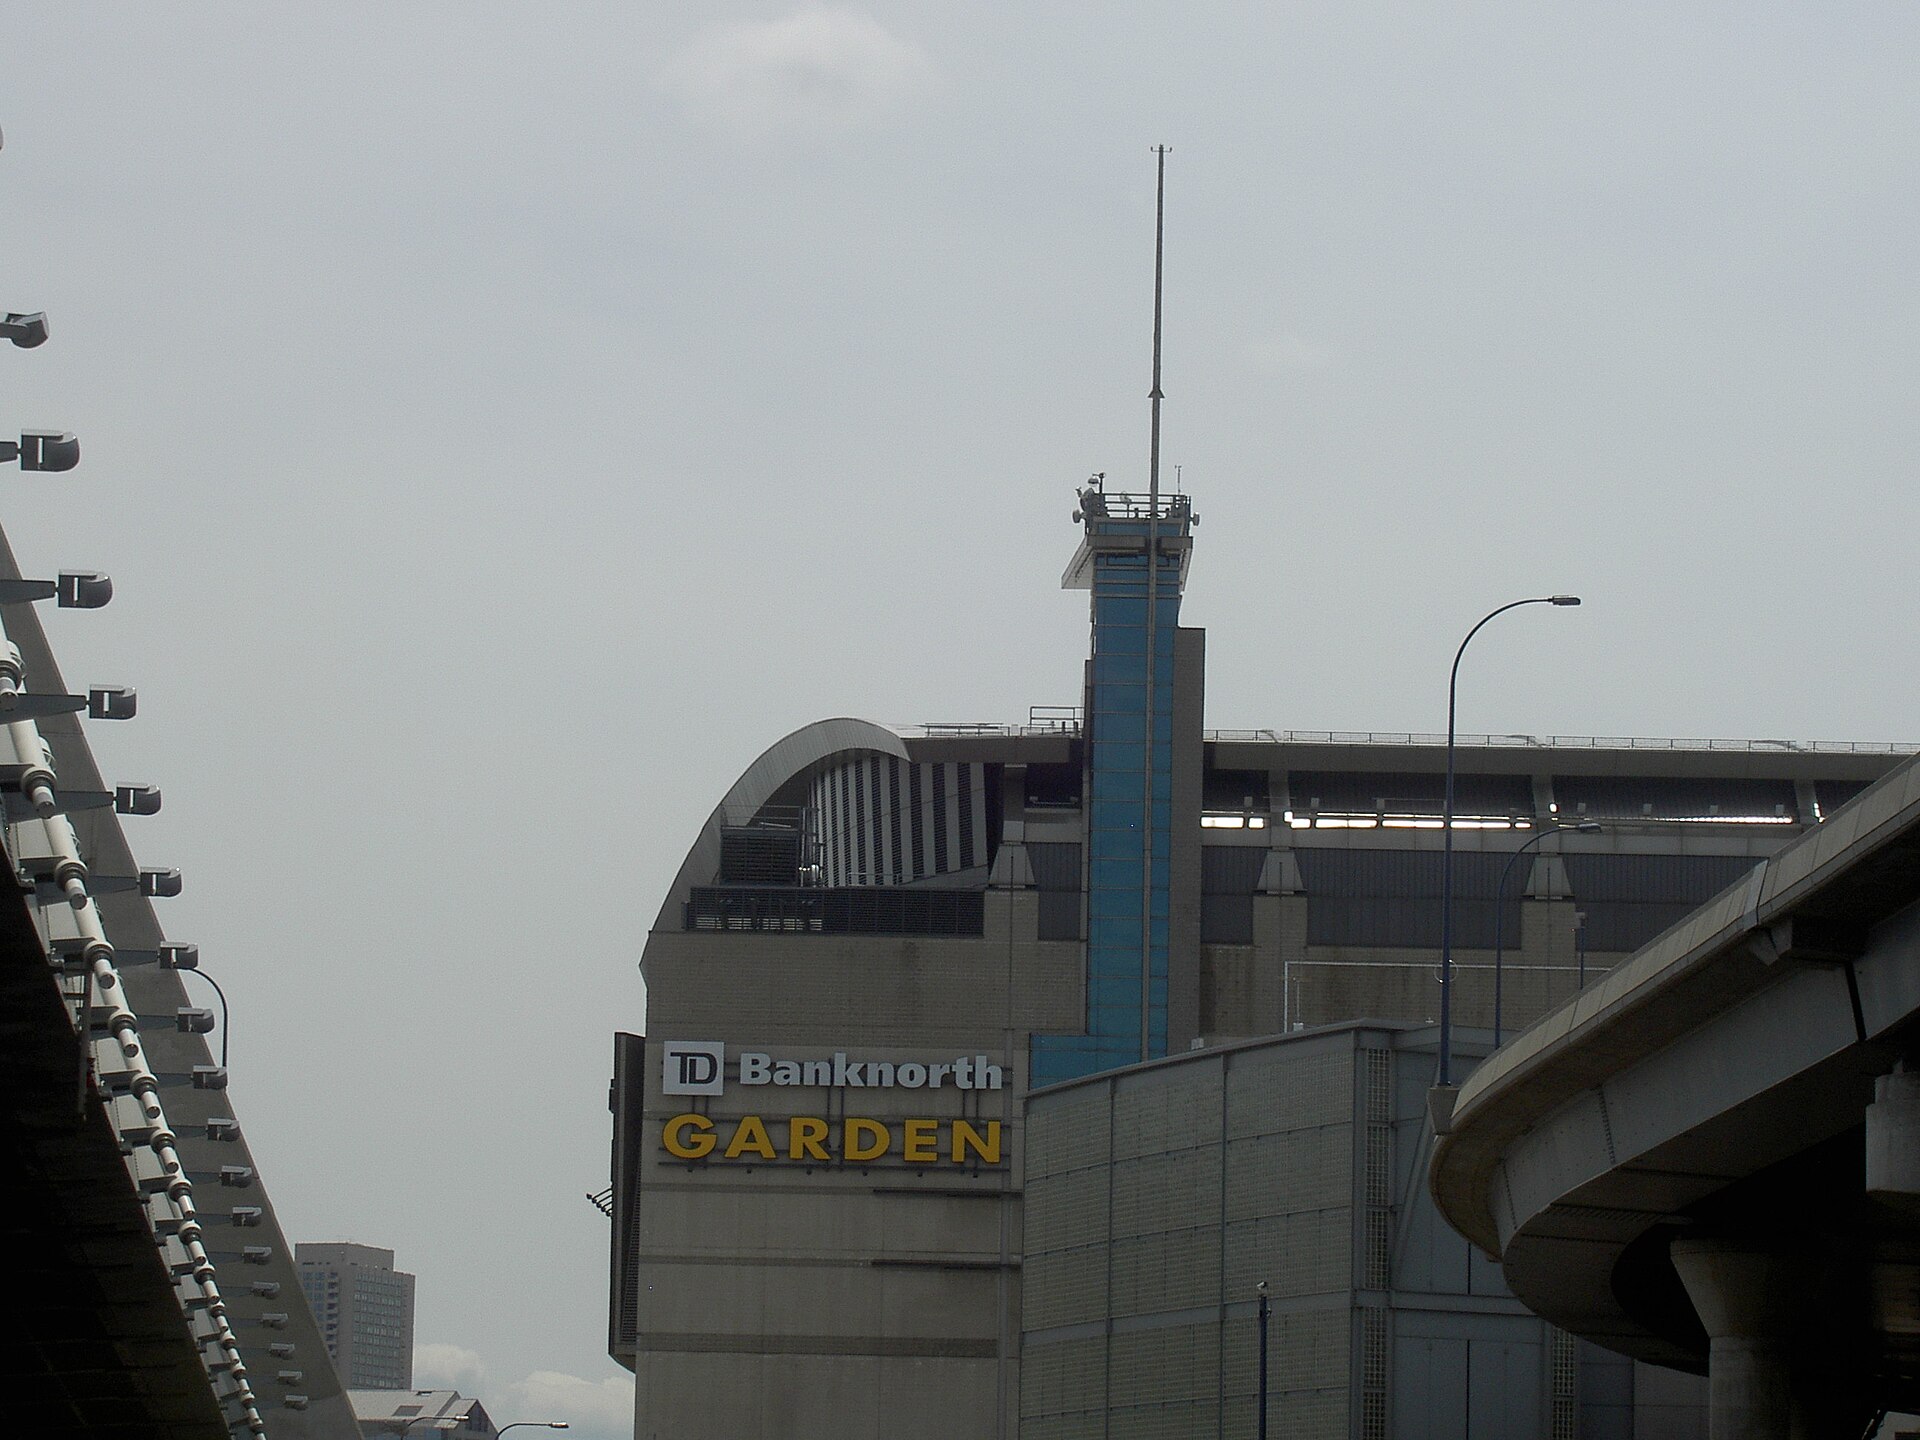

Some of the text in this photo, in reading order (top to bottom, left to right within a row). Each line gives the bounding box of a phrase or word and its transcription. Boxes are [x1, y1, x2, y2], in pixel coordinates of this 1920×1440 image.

[669, 1051, 1003, 1090] TD Banknorth
[662, 1113, 1002, 1163] GARDEN
